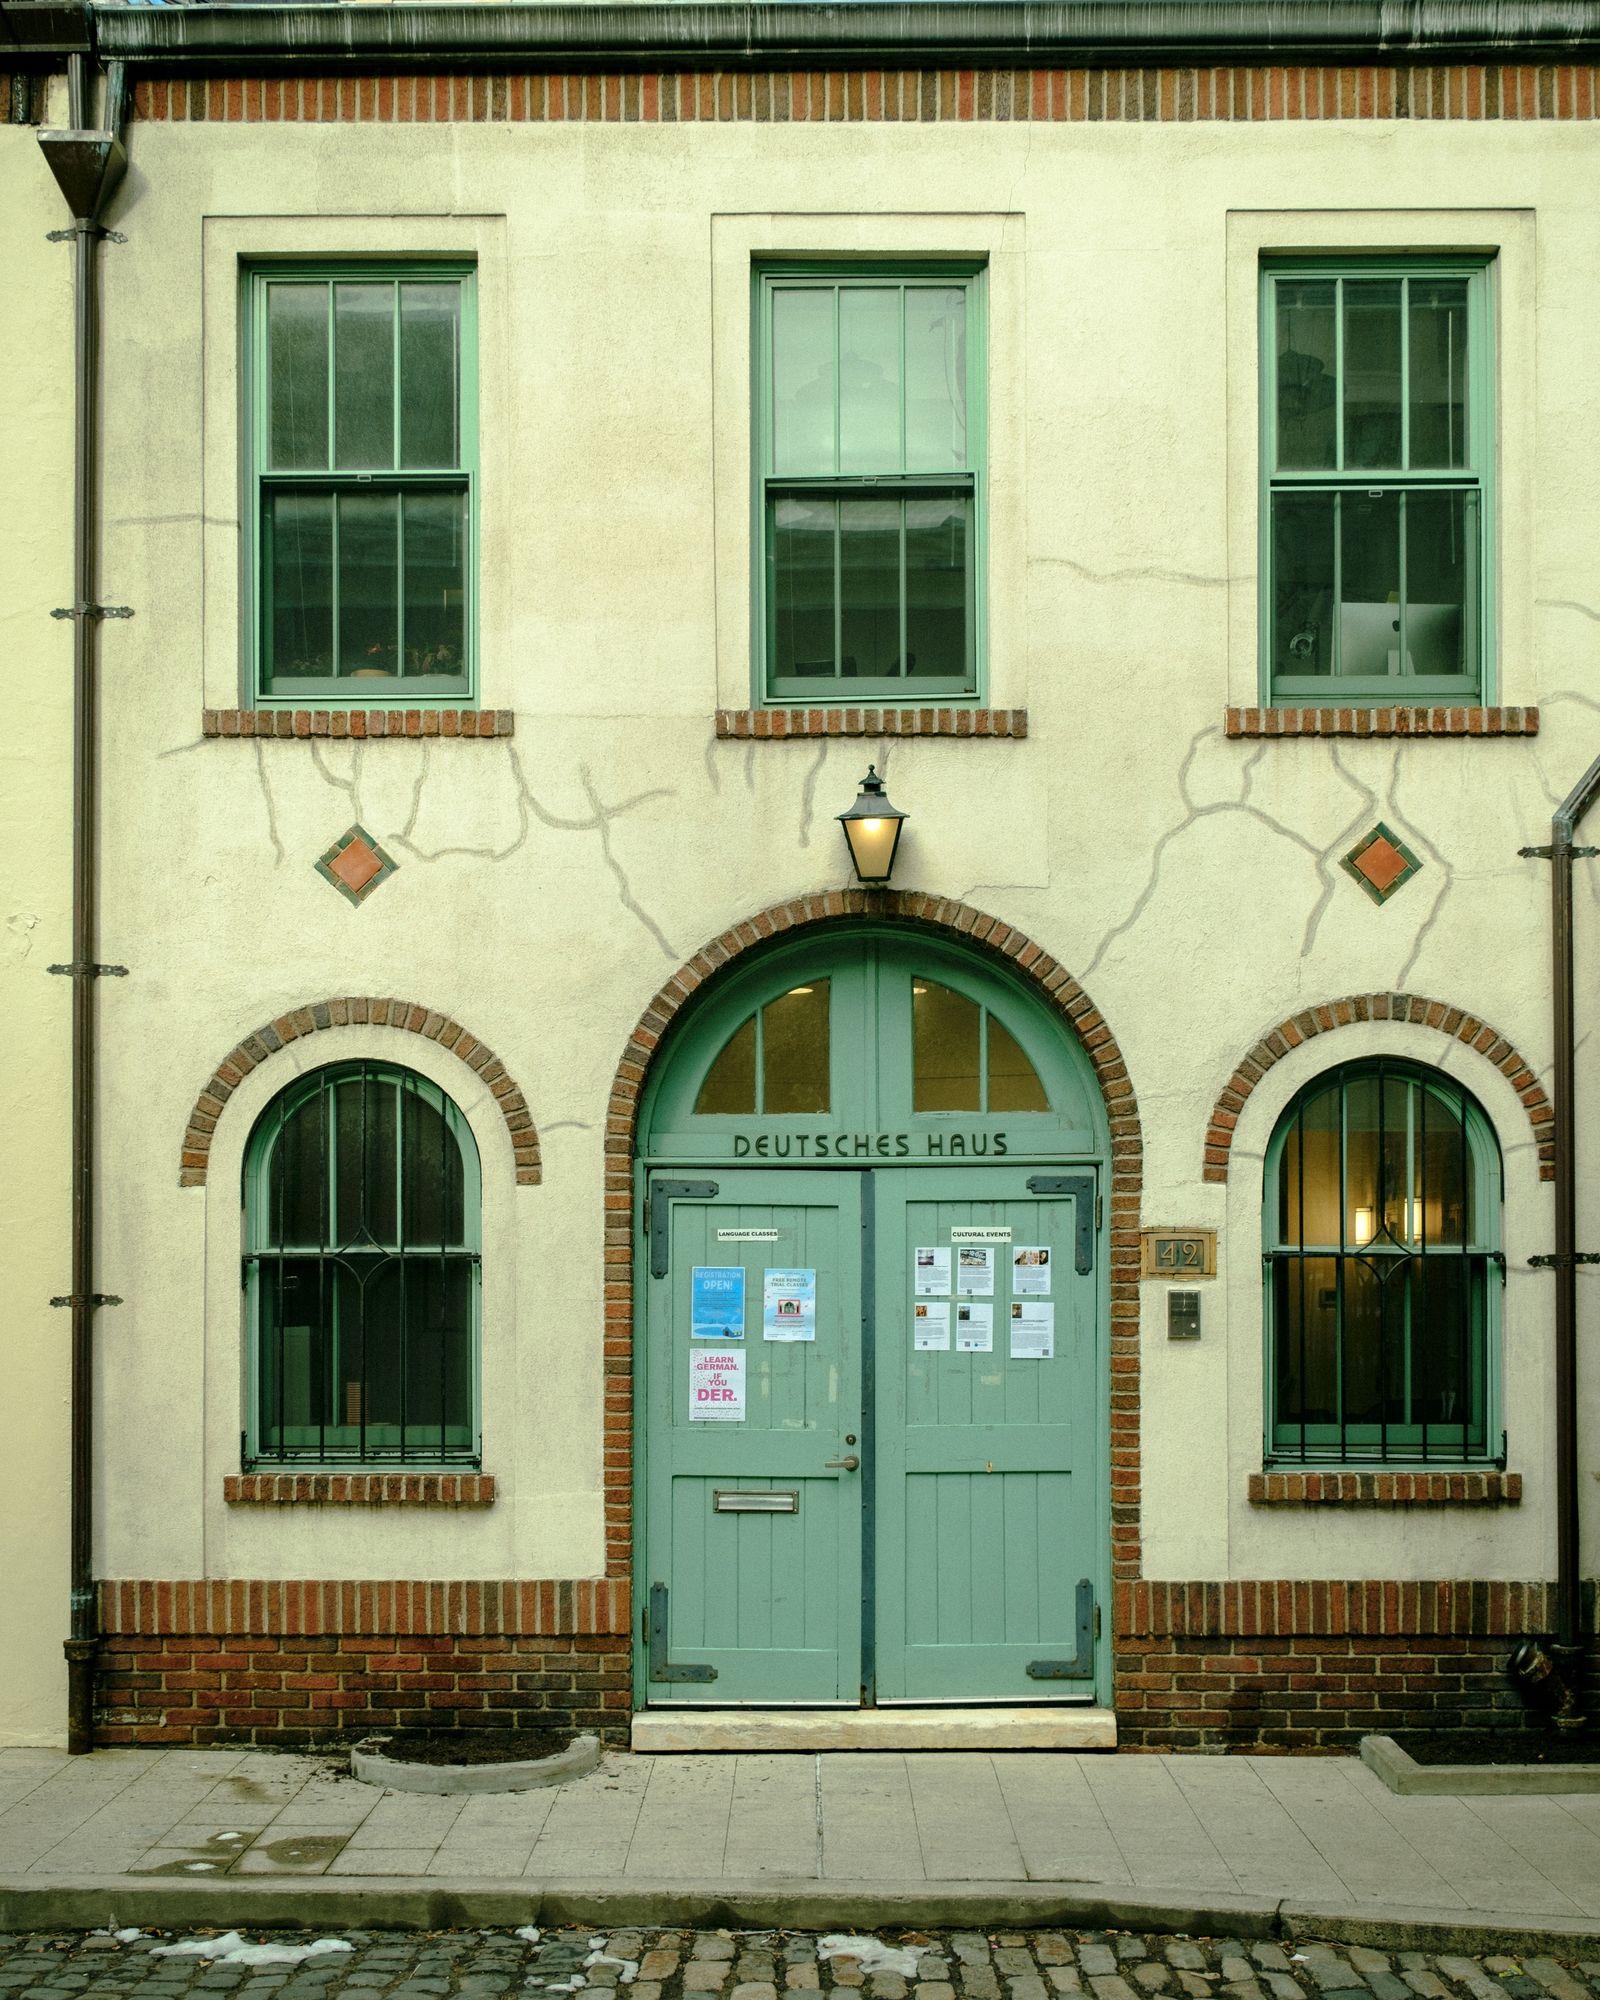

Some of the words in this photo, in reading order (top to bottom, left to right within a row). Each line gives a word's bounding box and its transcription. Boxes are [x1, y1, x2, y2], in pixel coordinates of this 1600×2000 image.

[734, 1134, 910, 1157] DEUTSCHES
[927, 1132, 1008, 1156] HAUS
[1160, 1240, 1198, 1267] 42
[695, 1271, 742, 1279] REGISTRATION
[703, 1280, 733, 1291] OPEN!
[696, 1363, 739, 1371] GERMAN.
[713, 1372, 722, 1380] IF
[708, 1379, 727, 1387] YOU
[697, 1388, 737, 1402] DER.
